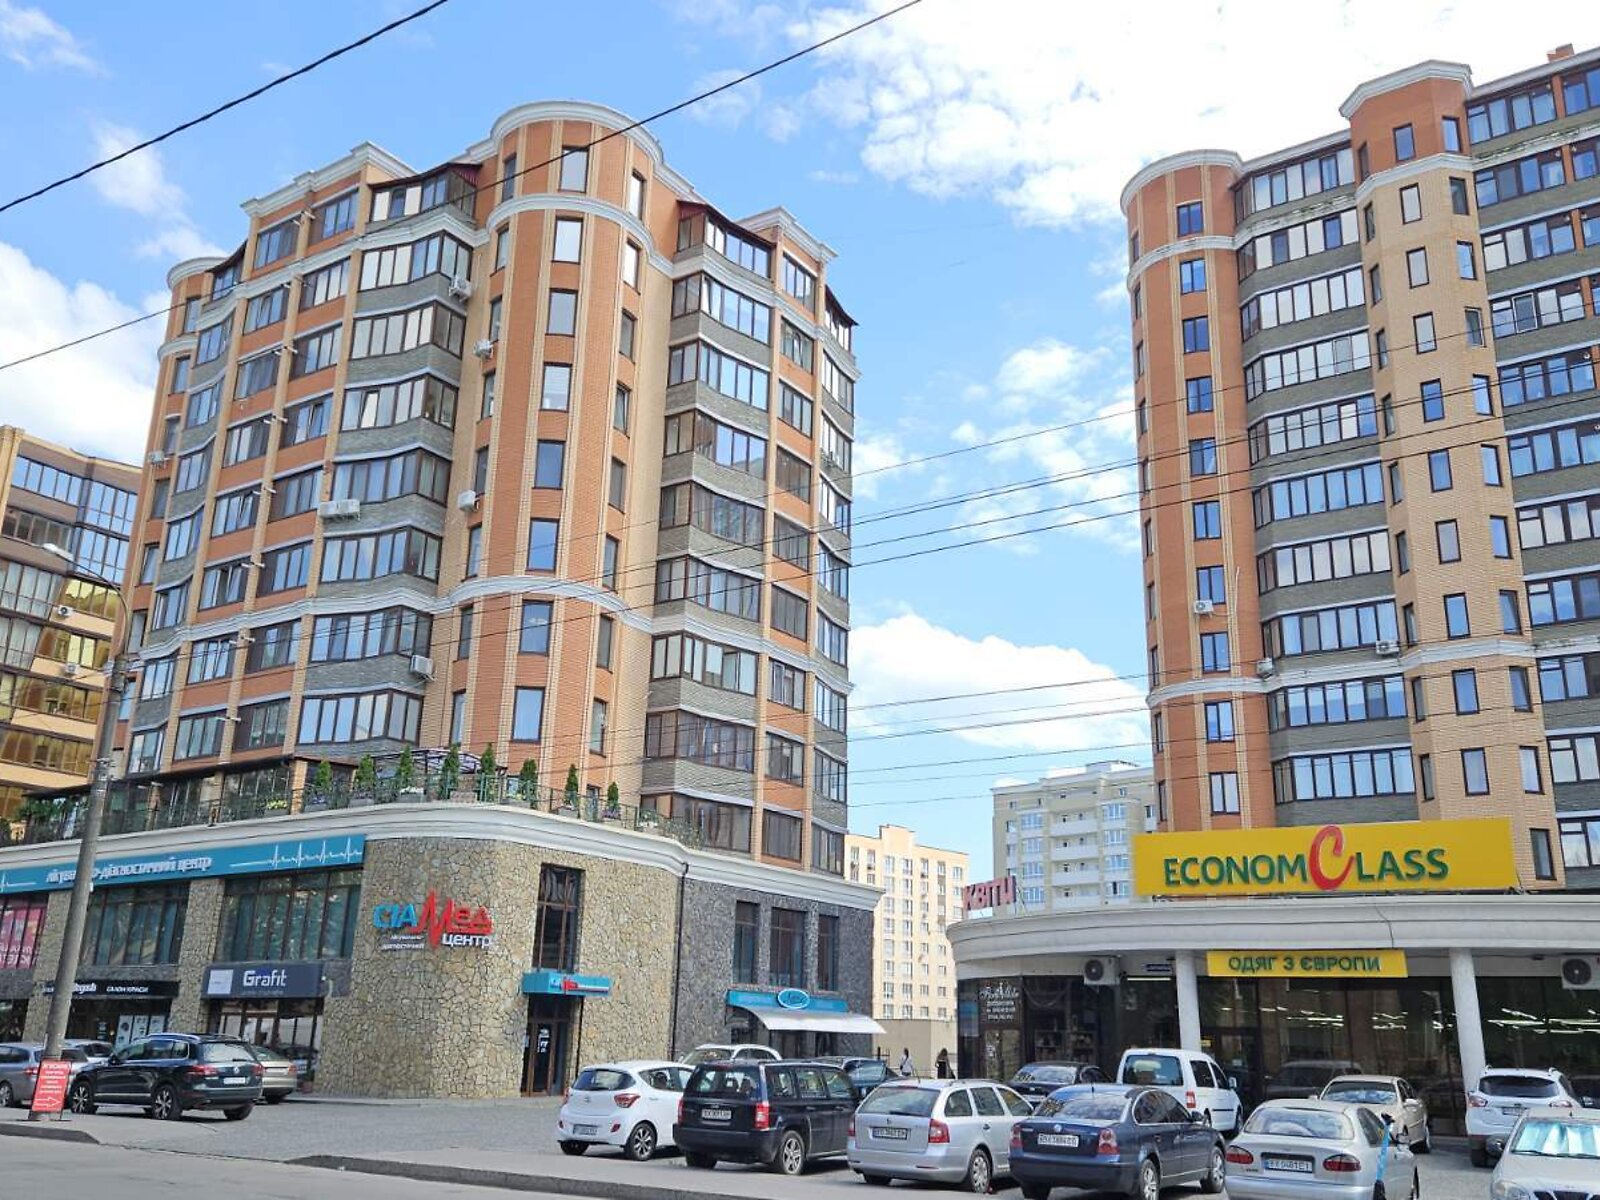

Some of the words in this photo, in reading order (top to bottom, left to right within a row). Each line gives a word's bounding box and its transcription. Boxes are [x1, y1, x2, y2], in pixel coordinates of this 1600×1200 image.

[1228, 956, 1278, 973] ОДЯГ
[1283, 956, 1295, 971] З
[1300, 956, 1381, 972] ЄВРОПИ
[243, 969, 287, 987] Grafit
